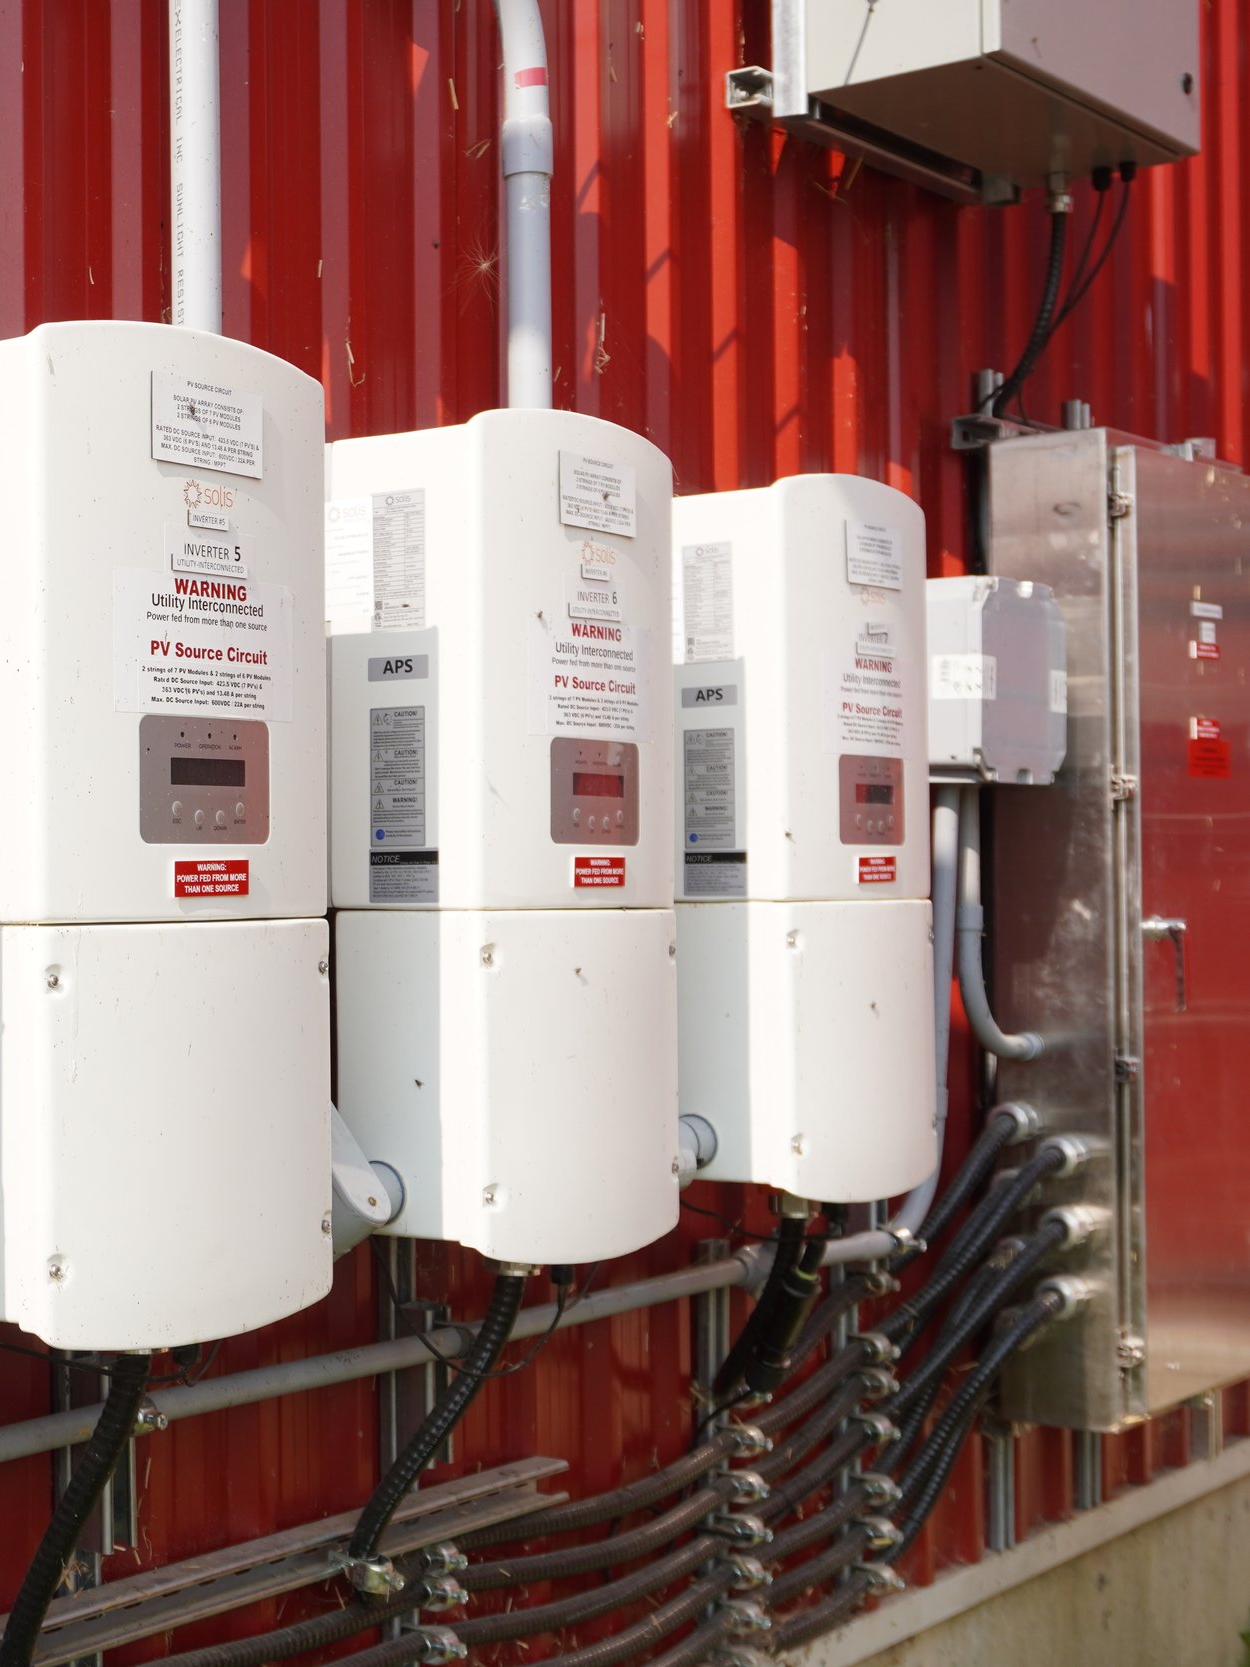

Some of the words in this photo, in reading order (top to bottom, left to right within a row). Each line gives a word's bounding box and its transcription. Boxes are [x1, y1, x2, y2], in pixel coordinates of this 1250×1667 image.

[176, 182, 184, 257] SUNLIGHT
[193, 515, 218, 524] INVERTER
[184, 544, 229, 560] INVERTER
[235, 546, 240, 561] 5
[177, 559, 244, 573] UTILITY-INTERCONNECTED
[175, 578, 246, 601] WARNING
[152, 593, 185, 612] Utility
[189, 597, 263, 617] Interconnected
[577, 592, 609, 604] INVERTER
[612, 592, 617, 605] 6
[147, 612, 169, 621] Power
[172, 613, 182, 622] fed
[184, 615, 200, 624] from
[202, 618, 218, 626] more
[220, 619, 233, 628] than
[248, 623, 267, 631] source
[572, 623, 622, 641] WARNING
[151, 640, 170, 656] PV
[175, 642, 223, 661] Source
[227, 647, 267, 665] Circuit
[556, 642, 579, 657] Utility
[582, 645, 633, 661] Interconnected
[383, 659, 413, 674] APS
[855, 658, 893, 673] WARNING
[555, 675, 568, 688] PV
[572, 676, 606, 691] Source
[608, 680, 636, 694] Circuit
[696, 688, 723, 701] APS
[843, 702, 853, 712] PV
[856, 704, 881, 716] Source
[372, 855, 399, 864] NOTICE
[213, 874, 229, 882] FROM
[215, 884, 239, 892] SOURCE
